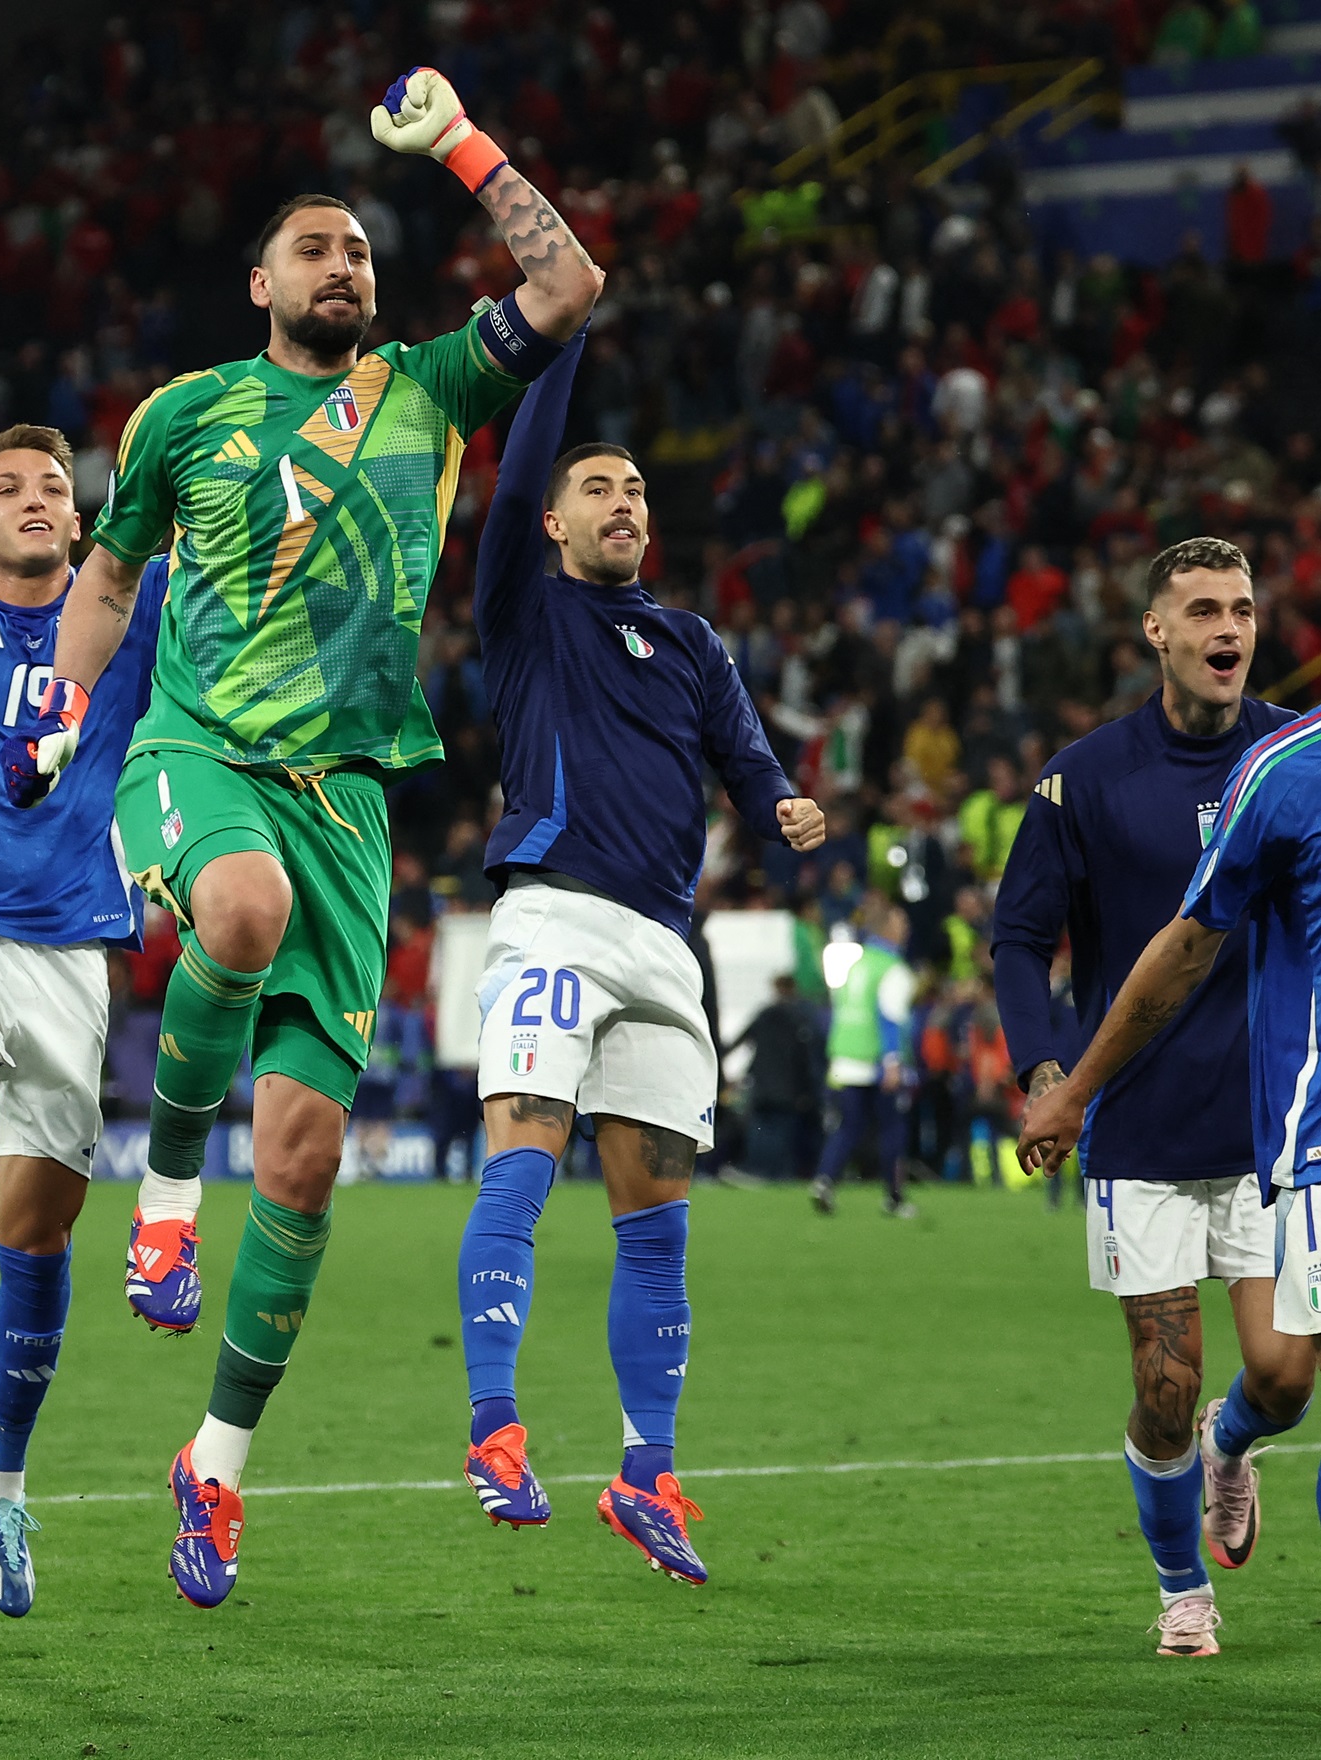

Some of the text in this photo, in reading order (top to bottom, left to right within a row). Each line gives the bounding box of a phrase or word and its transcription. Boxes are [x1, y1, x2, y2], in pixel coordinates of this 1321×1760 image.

[278, 453, 305, 523] 1
[2, 663, 55, 727] 19
[157, 768, 172, 815] 1
[511, 967, 581, 1031] 20
[512, 1042, 535, 1050] ITALIA
[472, 1269, 528, 1291] ITALIA
[5, 1330, 63, 1347] ITALIA
